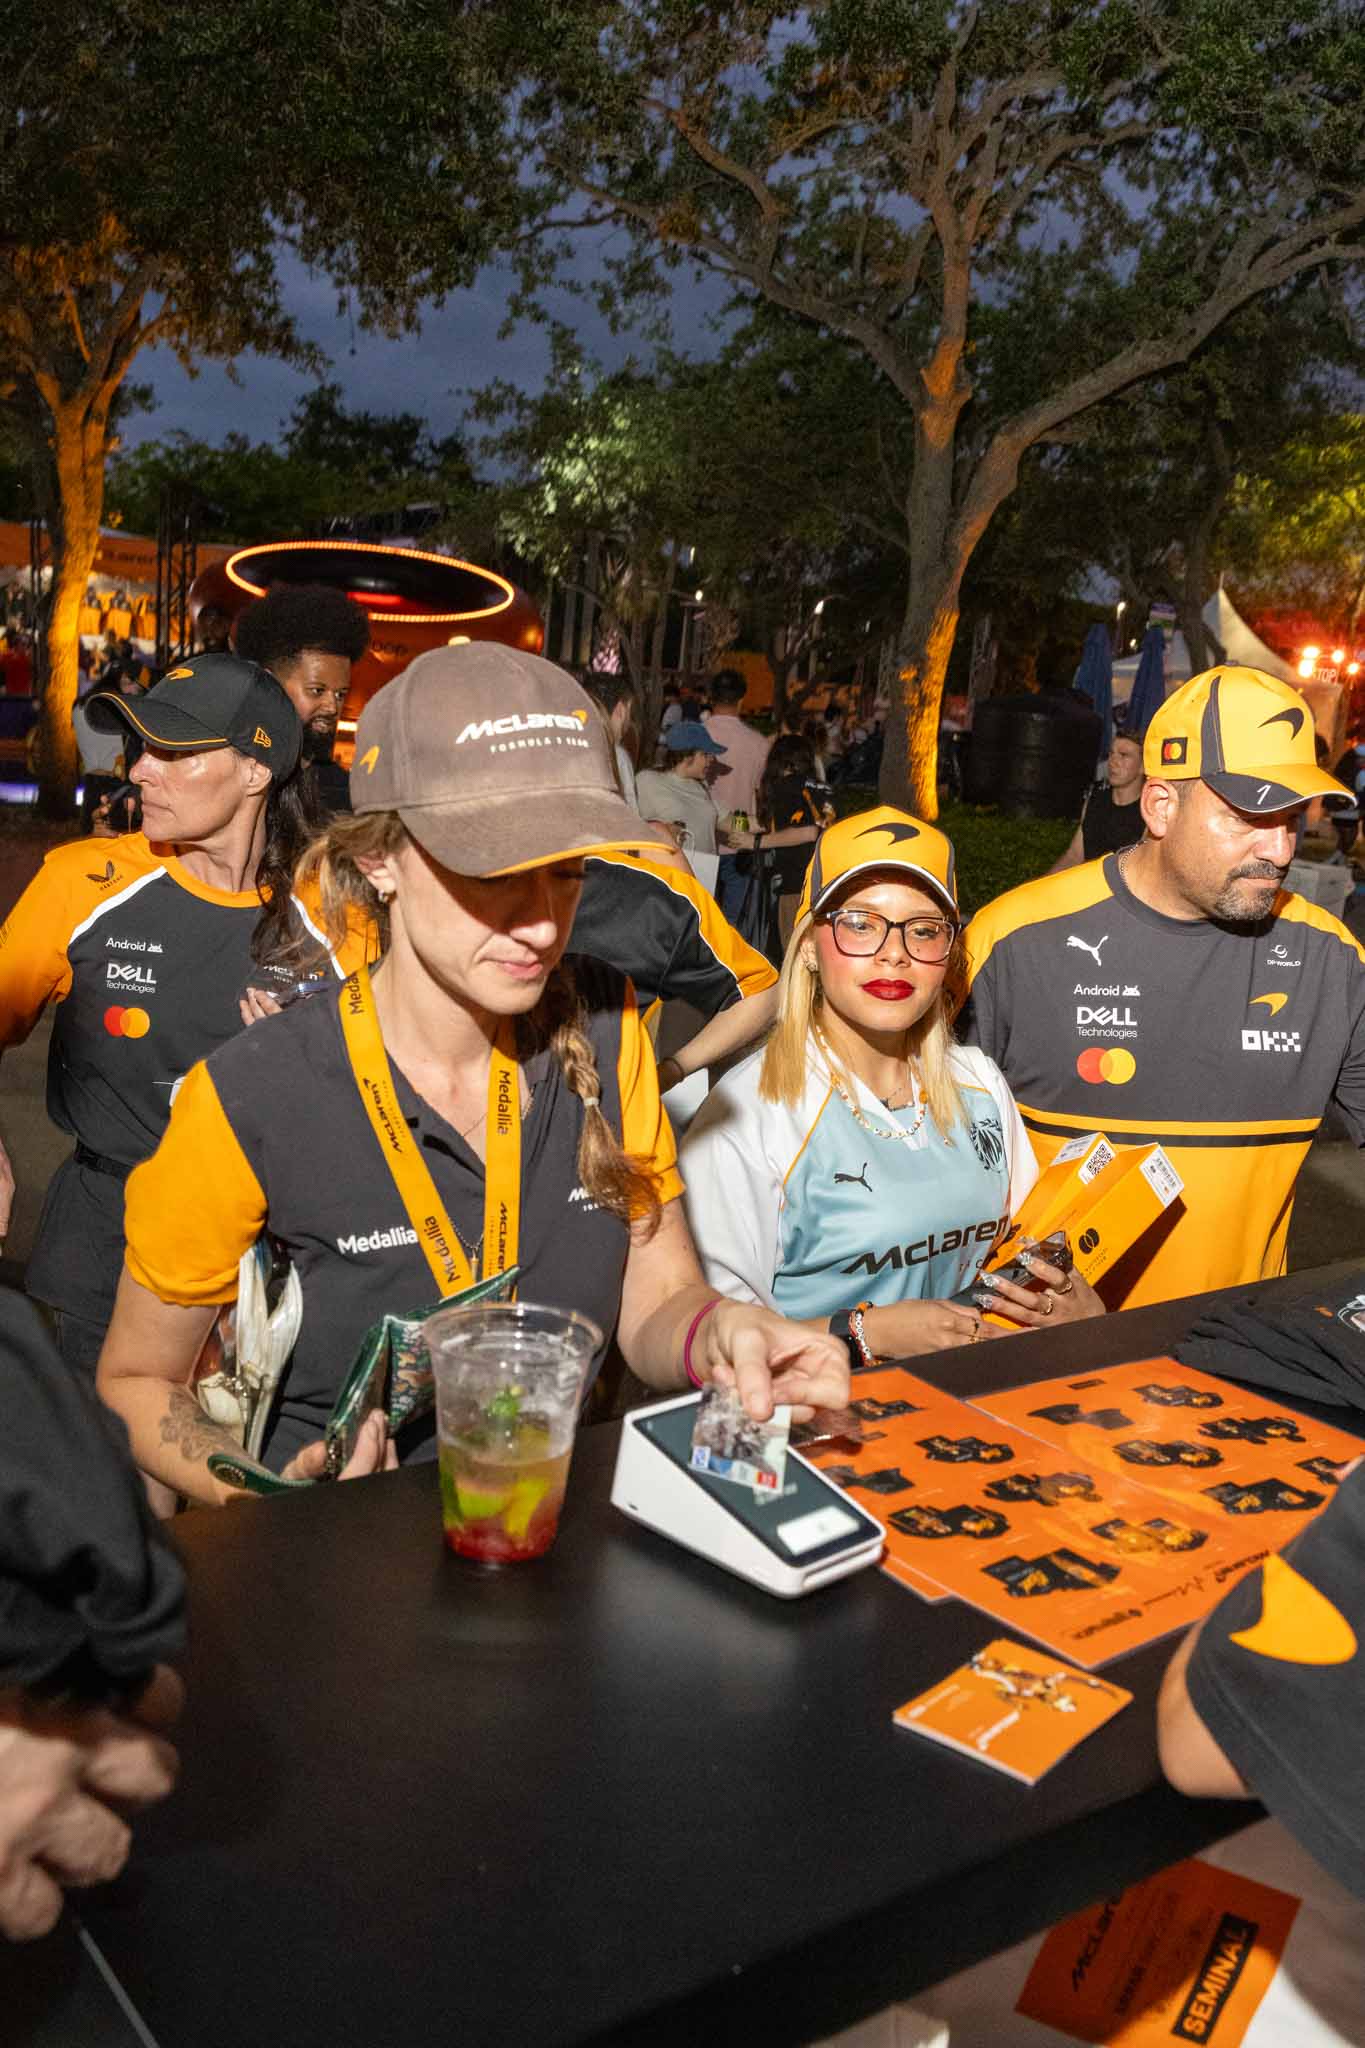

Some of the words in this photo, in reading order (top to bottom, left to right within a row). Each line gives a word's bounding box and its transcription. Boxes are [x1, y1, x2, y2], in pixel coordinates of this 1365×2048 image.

[455, 713, 584, 744] McLaren
[1256, 784, 1272, 805] 1
[105, 937, 146, 951] Android
[106, 963, 157, 984] DELL
[106, 980, 156, 994] Technologies
[1073, 984, 1120, 996] Android
[1076, 1006, 1137, 1026] DELL
[1076, 1026, 1137, 1039] Technologies
[498, 1070, 512, 1135] Medallia
[369, 1081, 403, 1153] McLaren
[337, 1226, 418, 1254] Medallia
[424, 1215, 461, 1283] Medallia
[841, 1214, 1009, 1275] McLaren
